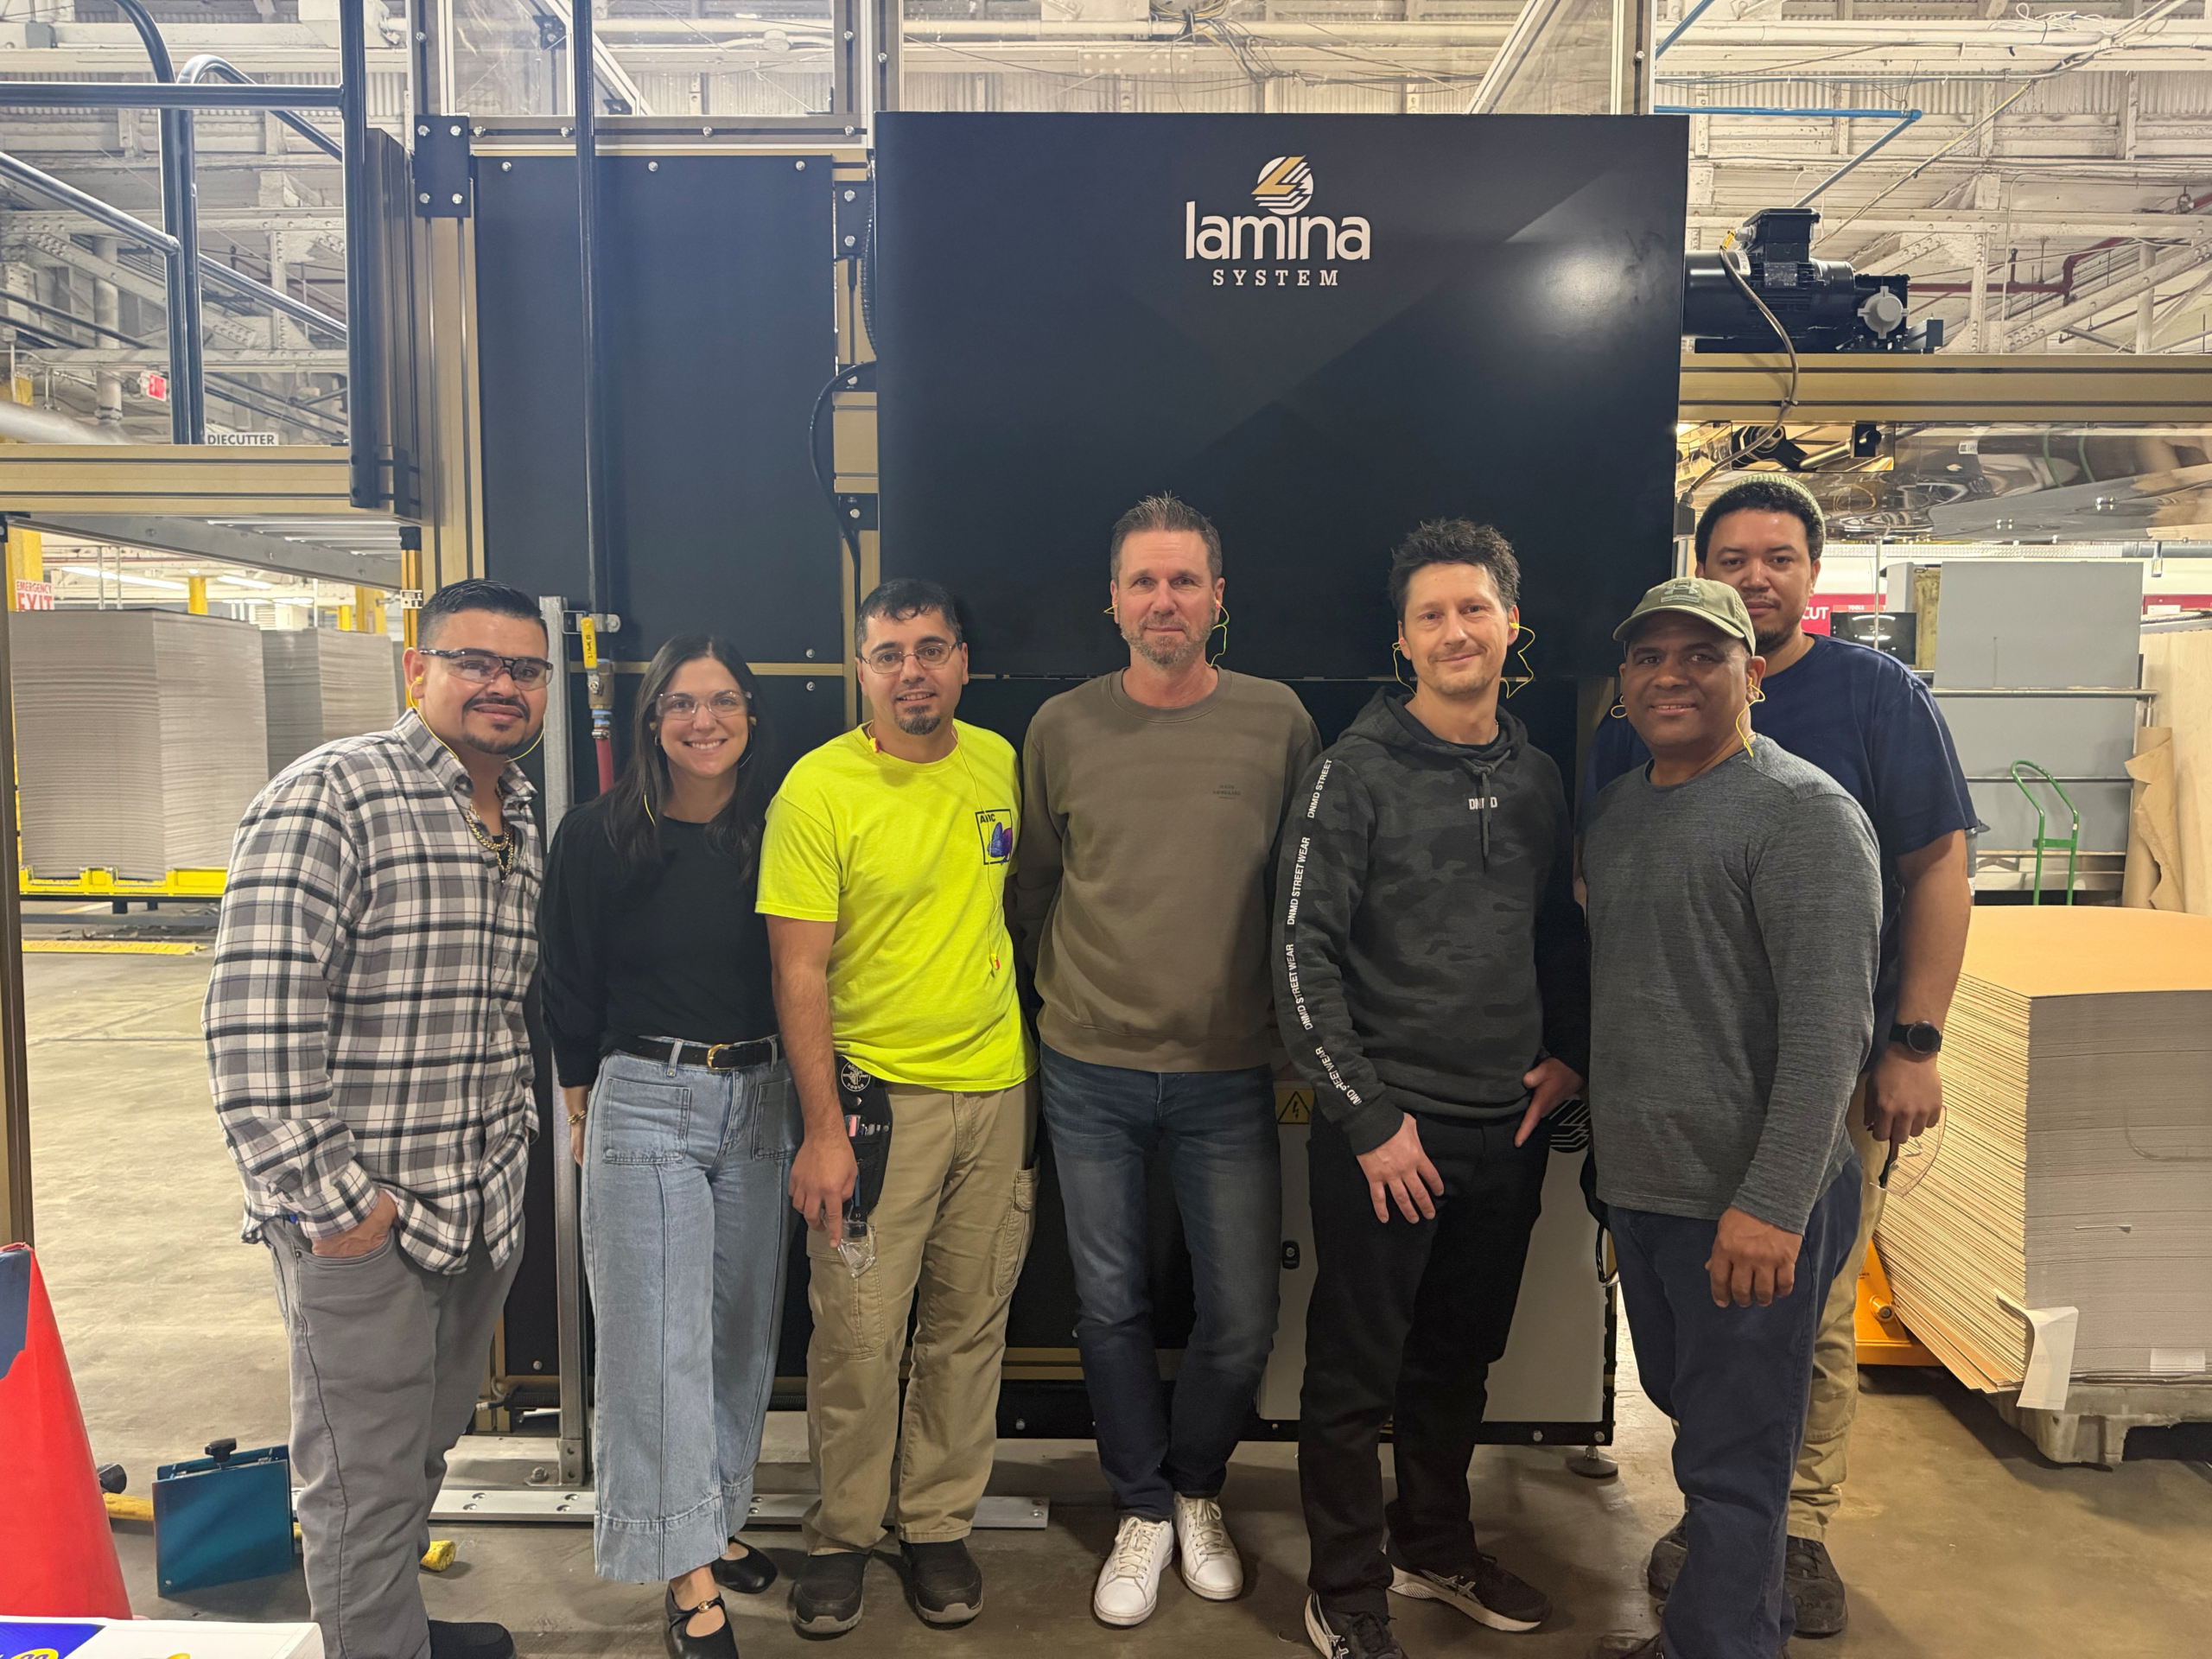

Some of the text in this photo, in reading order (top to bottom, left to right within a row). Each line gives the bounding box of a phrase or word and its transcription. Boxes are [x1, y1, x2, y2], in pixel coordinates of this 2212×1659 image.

[1185, 200, 1371, 261] lamina
[1212, 269, 1338, 286] SYSTEM
[207, 434, 275, 445] DIECUTTER
[16, 581, 52, 594] EMERGENCY
[1306, 759, 1332, 819] DNMD STREET
[1468, 796, 1498, 810] DND
[1287, 836, 1311, 925] DNMD STREET WEAR
[1285, 944, 1297, 971] WEAR
[1297, 1005, 1313, 1030] DNMD
[1315, 1046, 1335, 1071] WEAR
